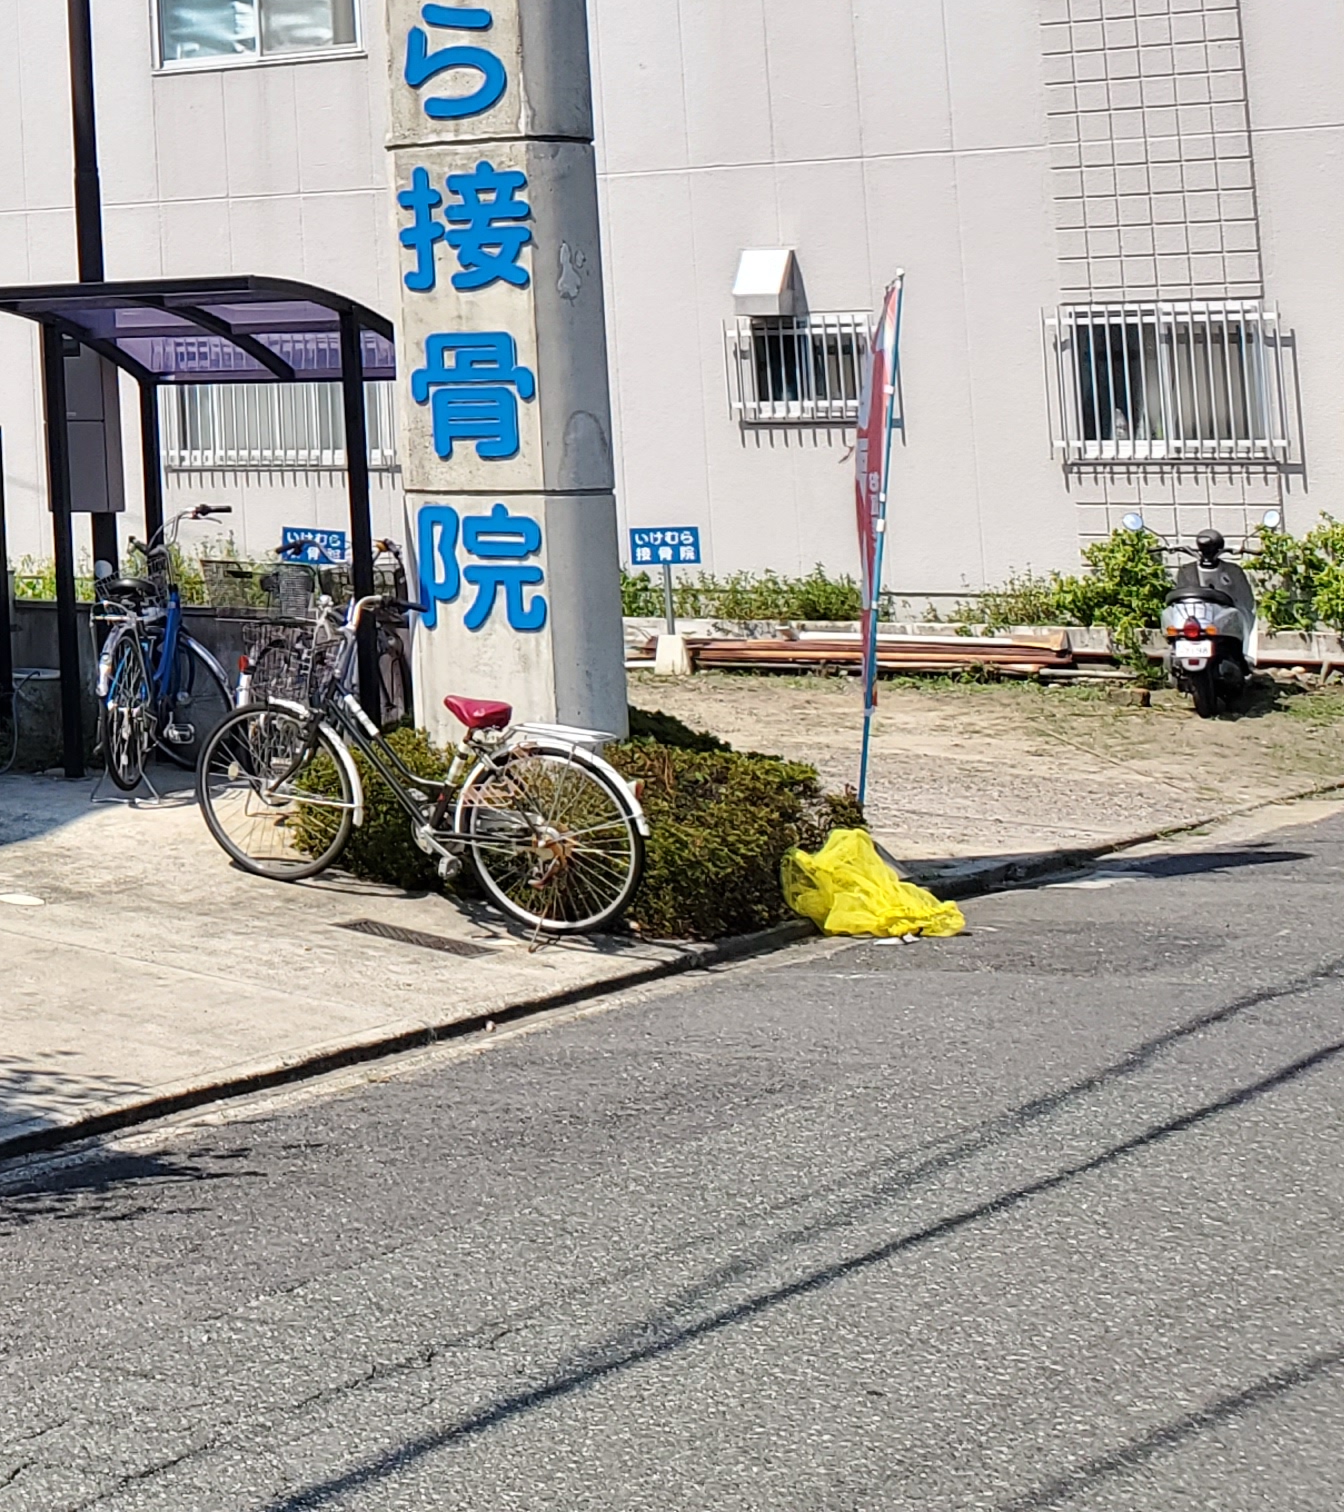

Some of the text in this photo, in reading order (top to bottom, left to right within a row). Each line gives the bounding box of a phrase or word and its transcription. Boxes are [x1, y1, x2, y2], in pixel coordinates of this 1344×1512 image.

[634, 531, 694, 545] いけむら
[635, 546, 696, 562] 接骨院
